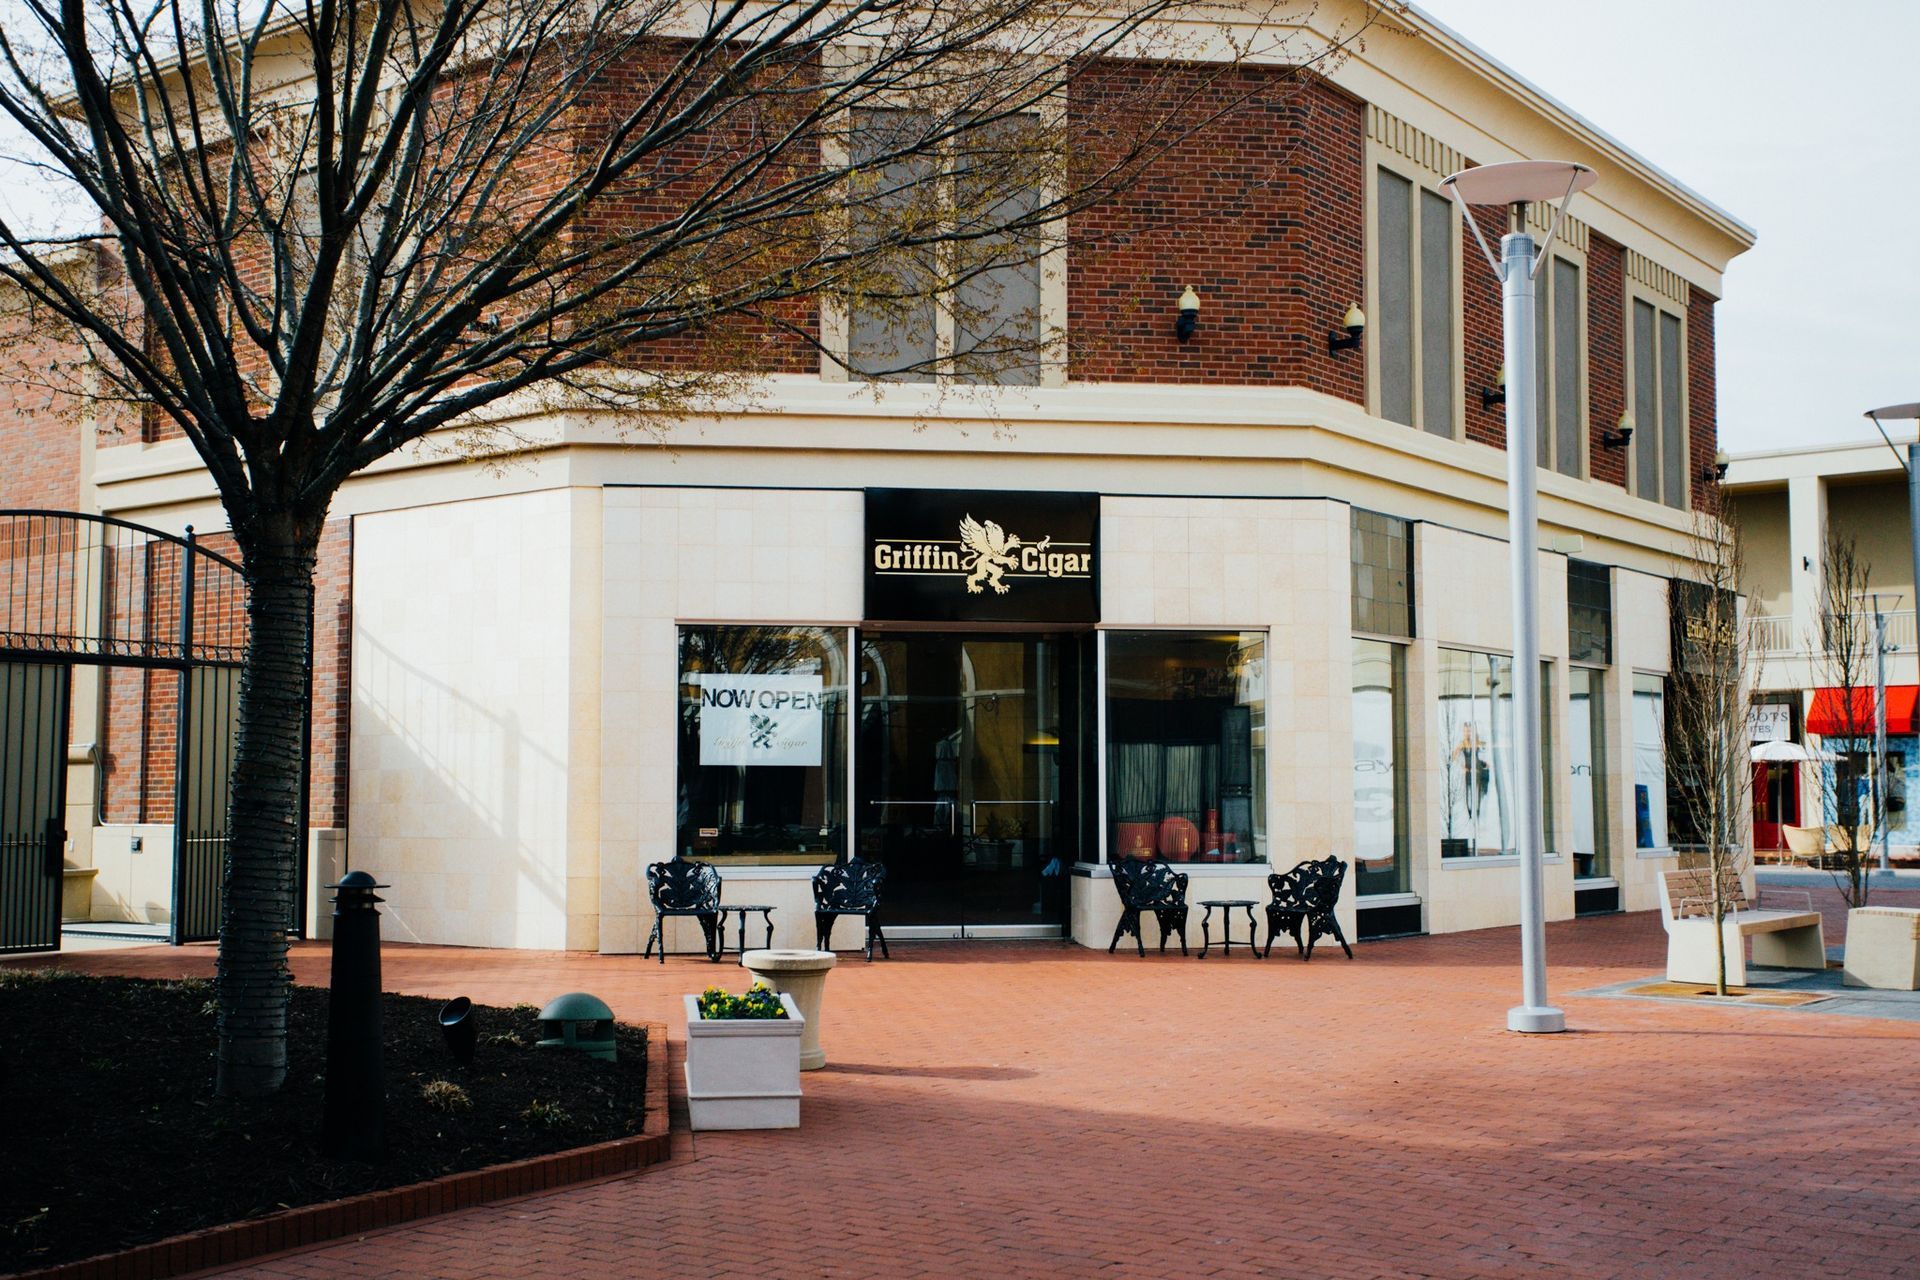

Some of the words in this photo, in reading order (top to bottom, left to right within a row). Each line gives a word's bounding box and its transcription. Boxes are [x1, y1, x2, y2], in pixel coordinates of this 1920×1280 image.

[874, 544, 960, 570] Griffin
[1021, 545, 1091, 578] Cigar
[701, 688, 755, 709] NOW
[758, 690, 822, 710] OPEN
[1748, 711, 1789, 723] BOTS
